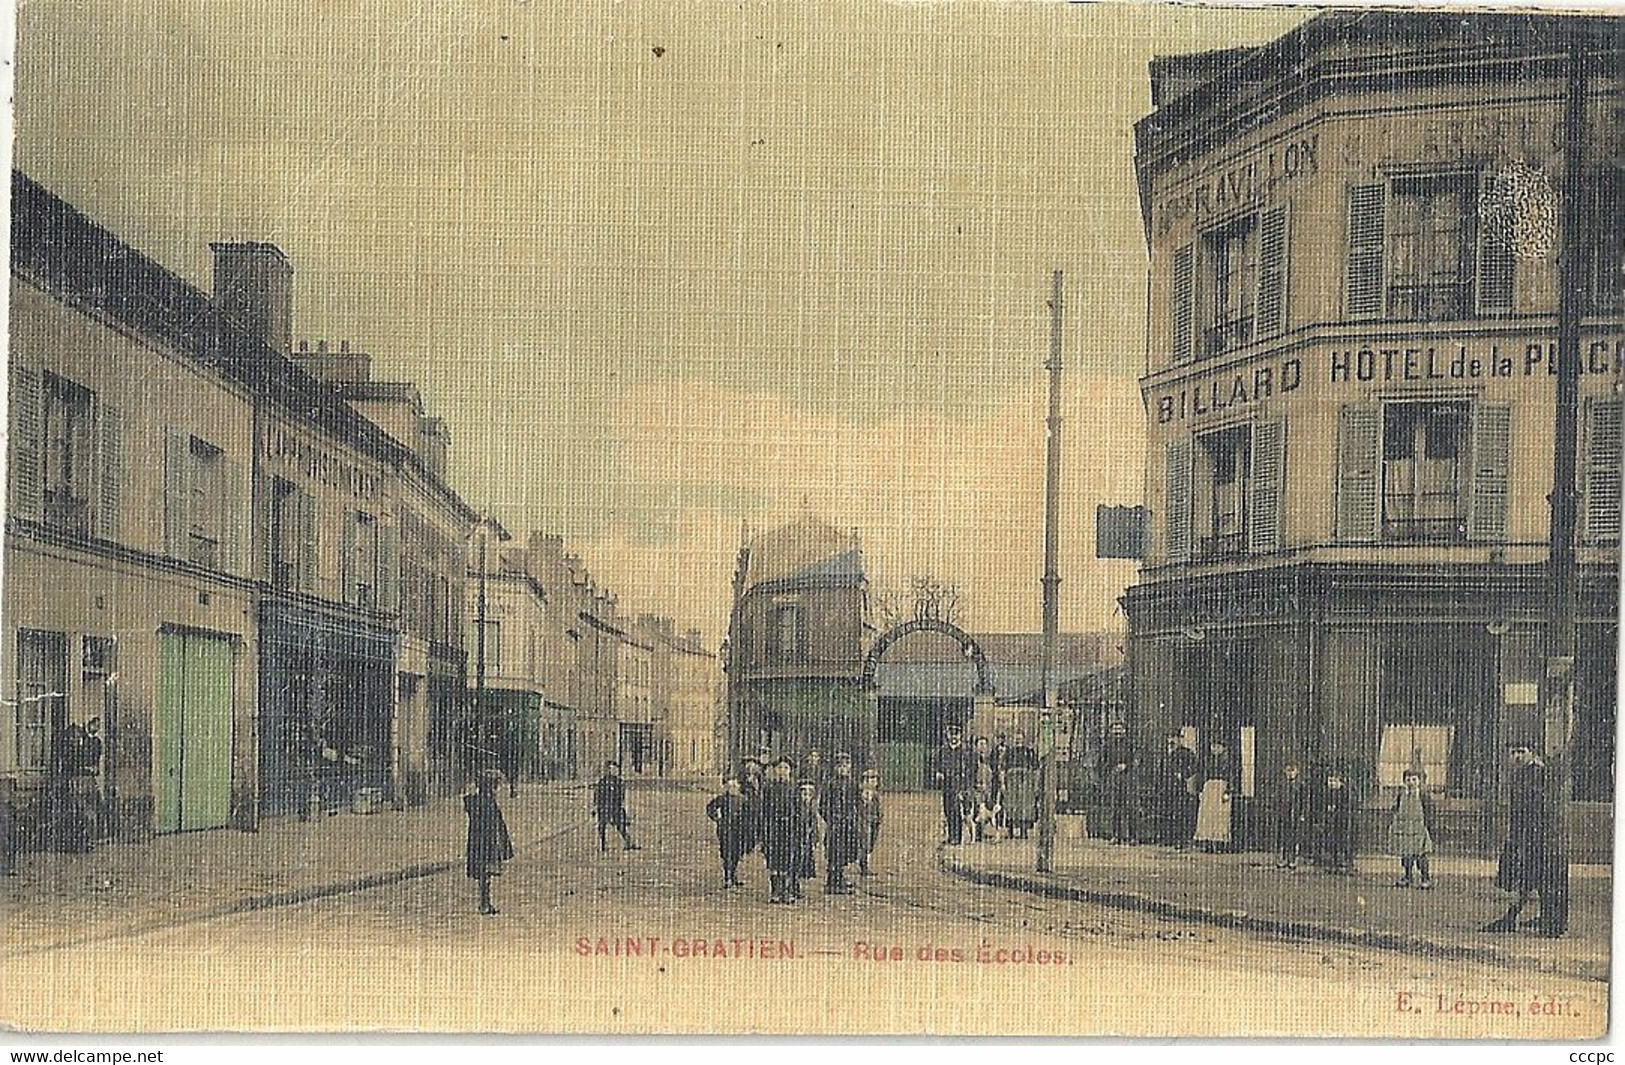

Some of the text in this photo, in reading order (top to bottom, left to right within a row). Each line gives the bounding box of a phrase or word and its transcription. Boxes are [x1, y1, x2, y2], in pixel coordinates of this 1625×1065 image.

[1331, 345, 1443, 384] HÔTEL
[1449, 347, 1481, 378] de
[1492, 346, 1512, 377] la
[1157, 358, 1301, 424] BILLARD
[853, 940, 905, 963] Rue
[917, 943, 964, 964] des
[1396, 992, 1581, 1018] E. Lépine, édit.
